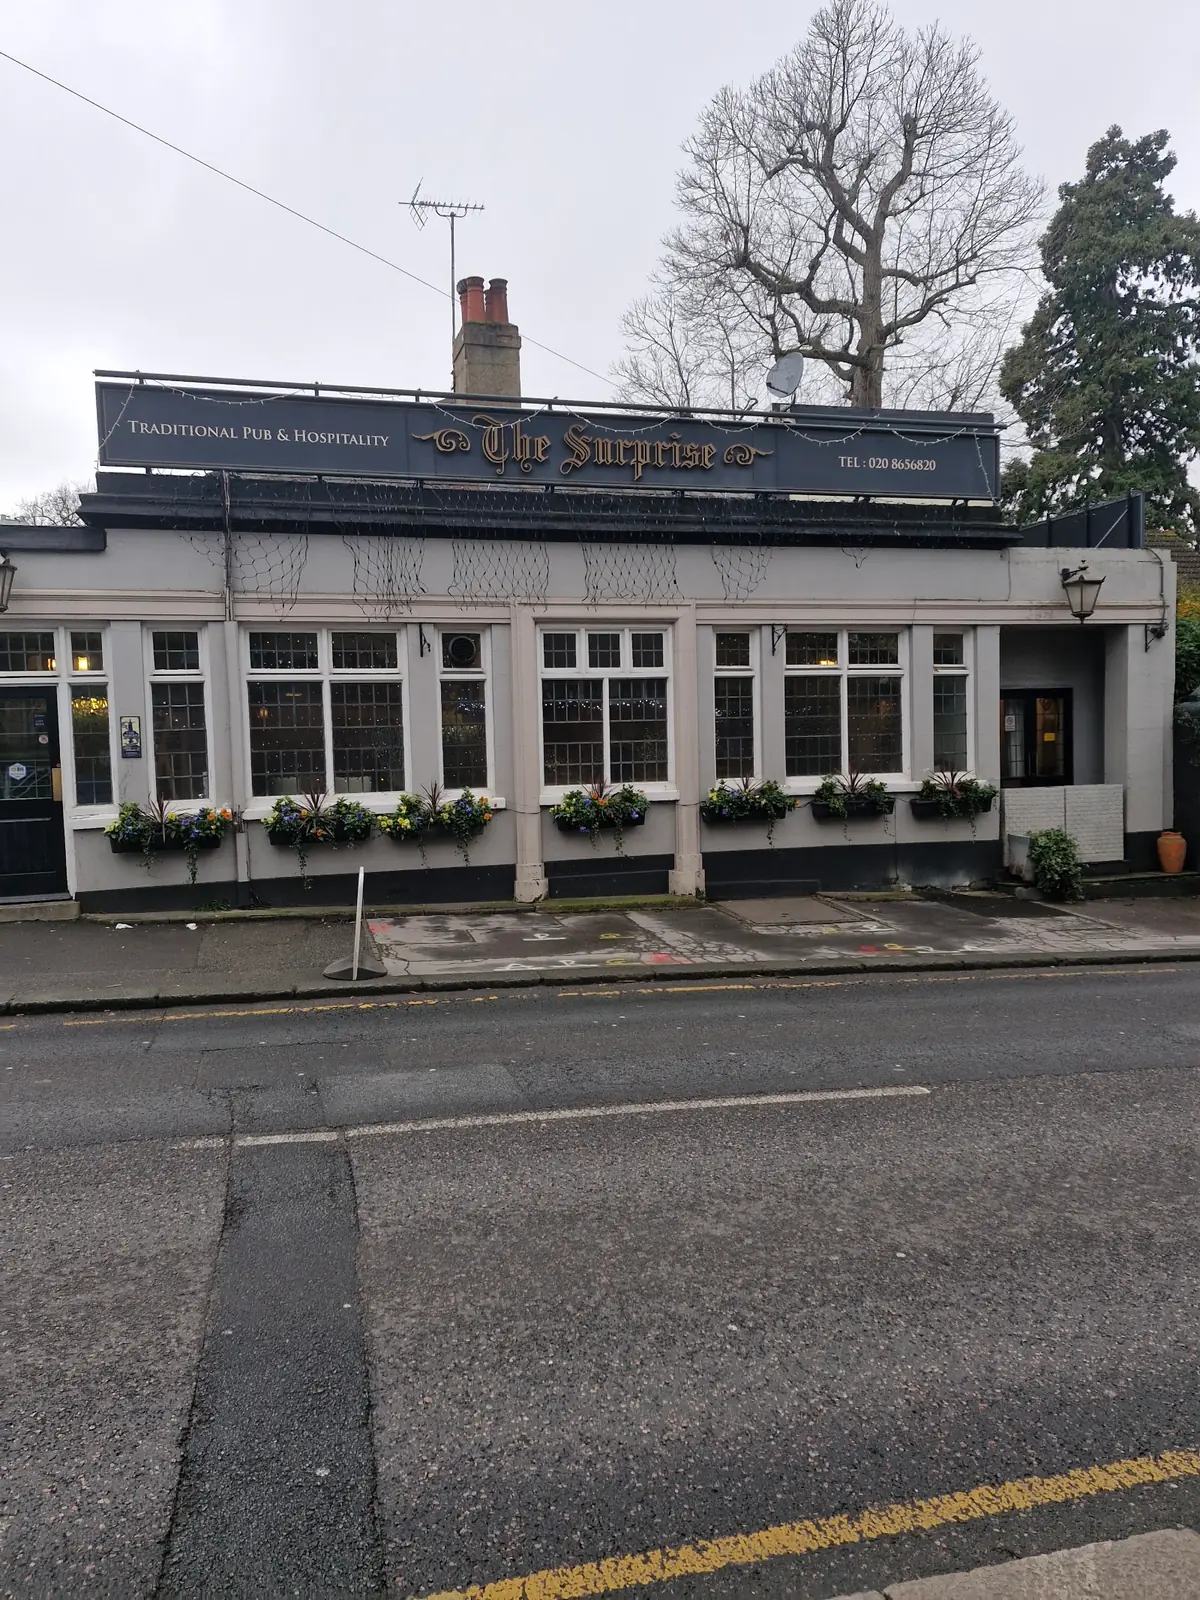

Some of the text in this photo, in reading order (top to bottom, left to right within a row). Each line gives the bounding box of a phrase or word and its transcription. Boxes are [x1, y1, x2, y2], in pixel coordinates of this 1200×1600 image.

[127, 420, 389, 447] TRADITIONAL PUB & HOSPITALITY
[471, 414, 717, 481] The Surprise
[868, 457, 888, 469] 020
[891, 458, 936, 471] 8656820
